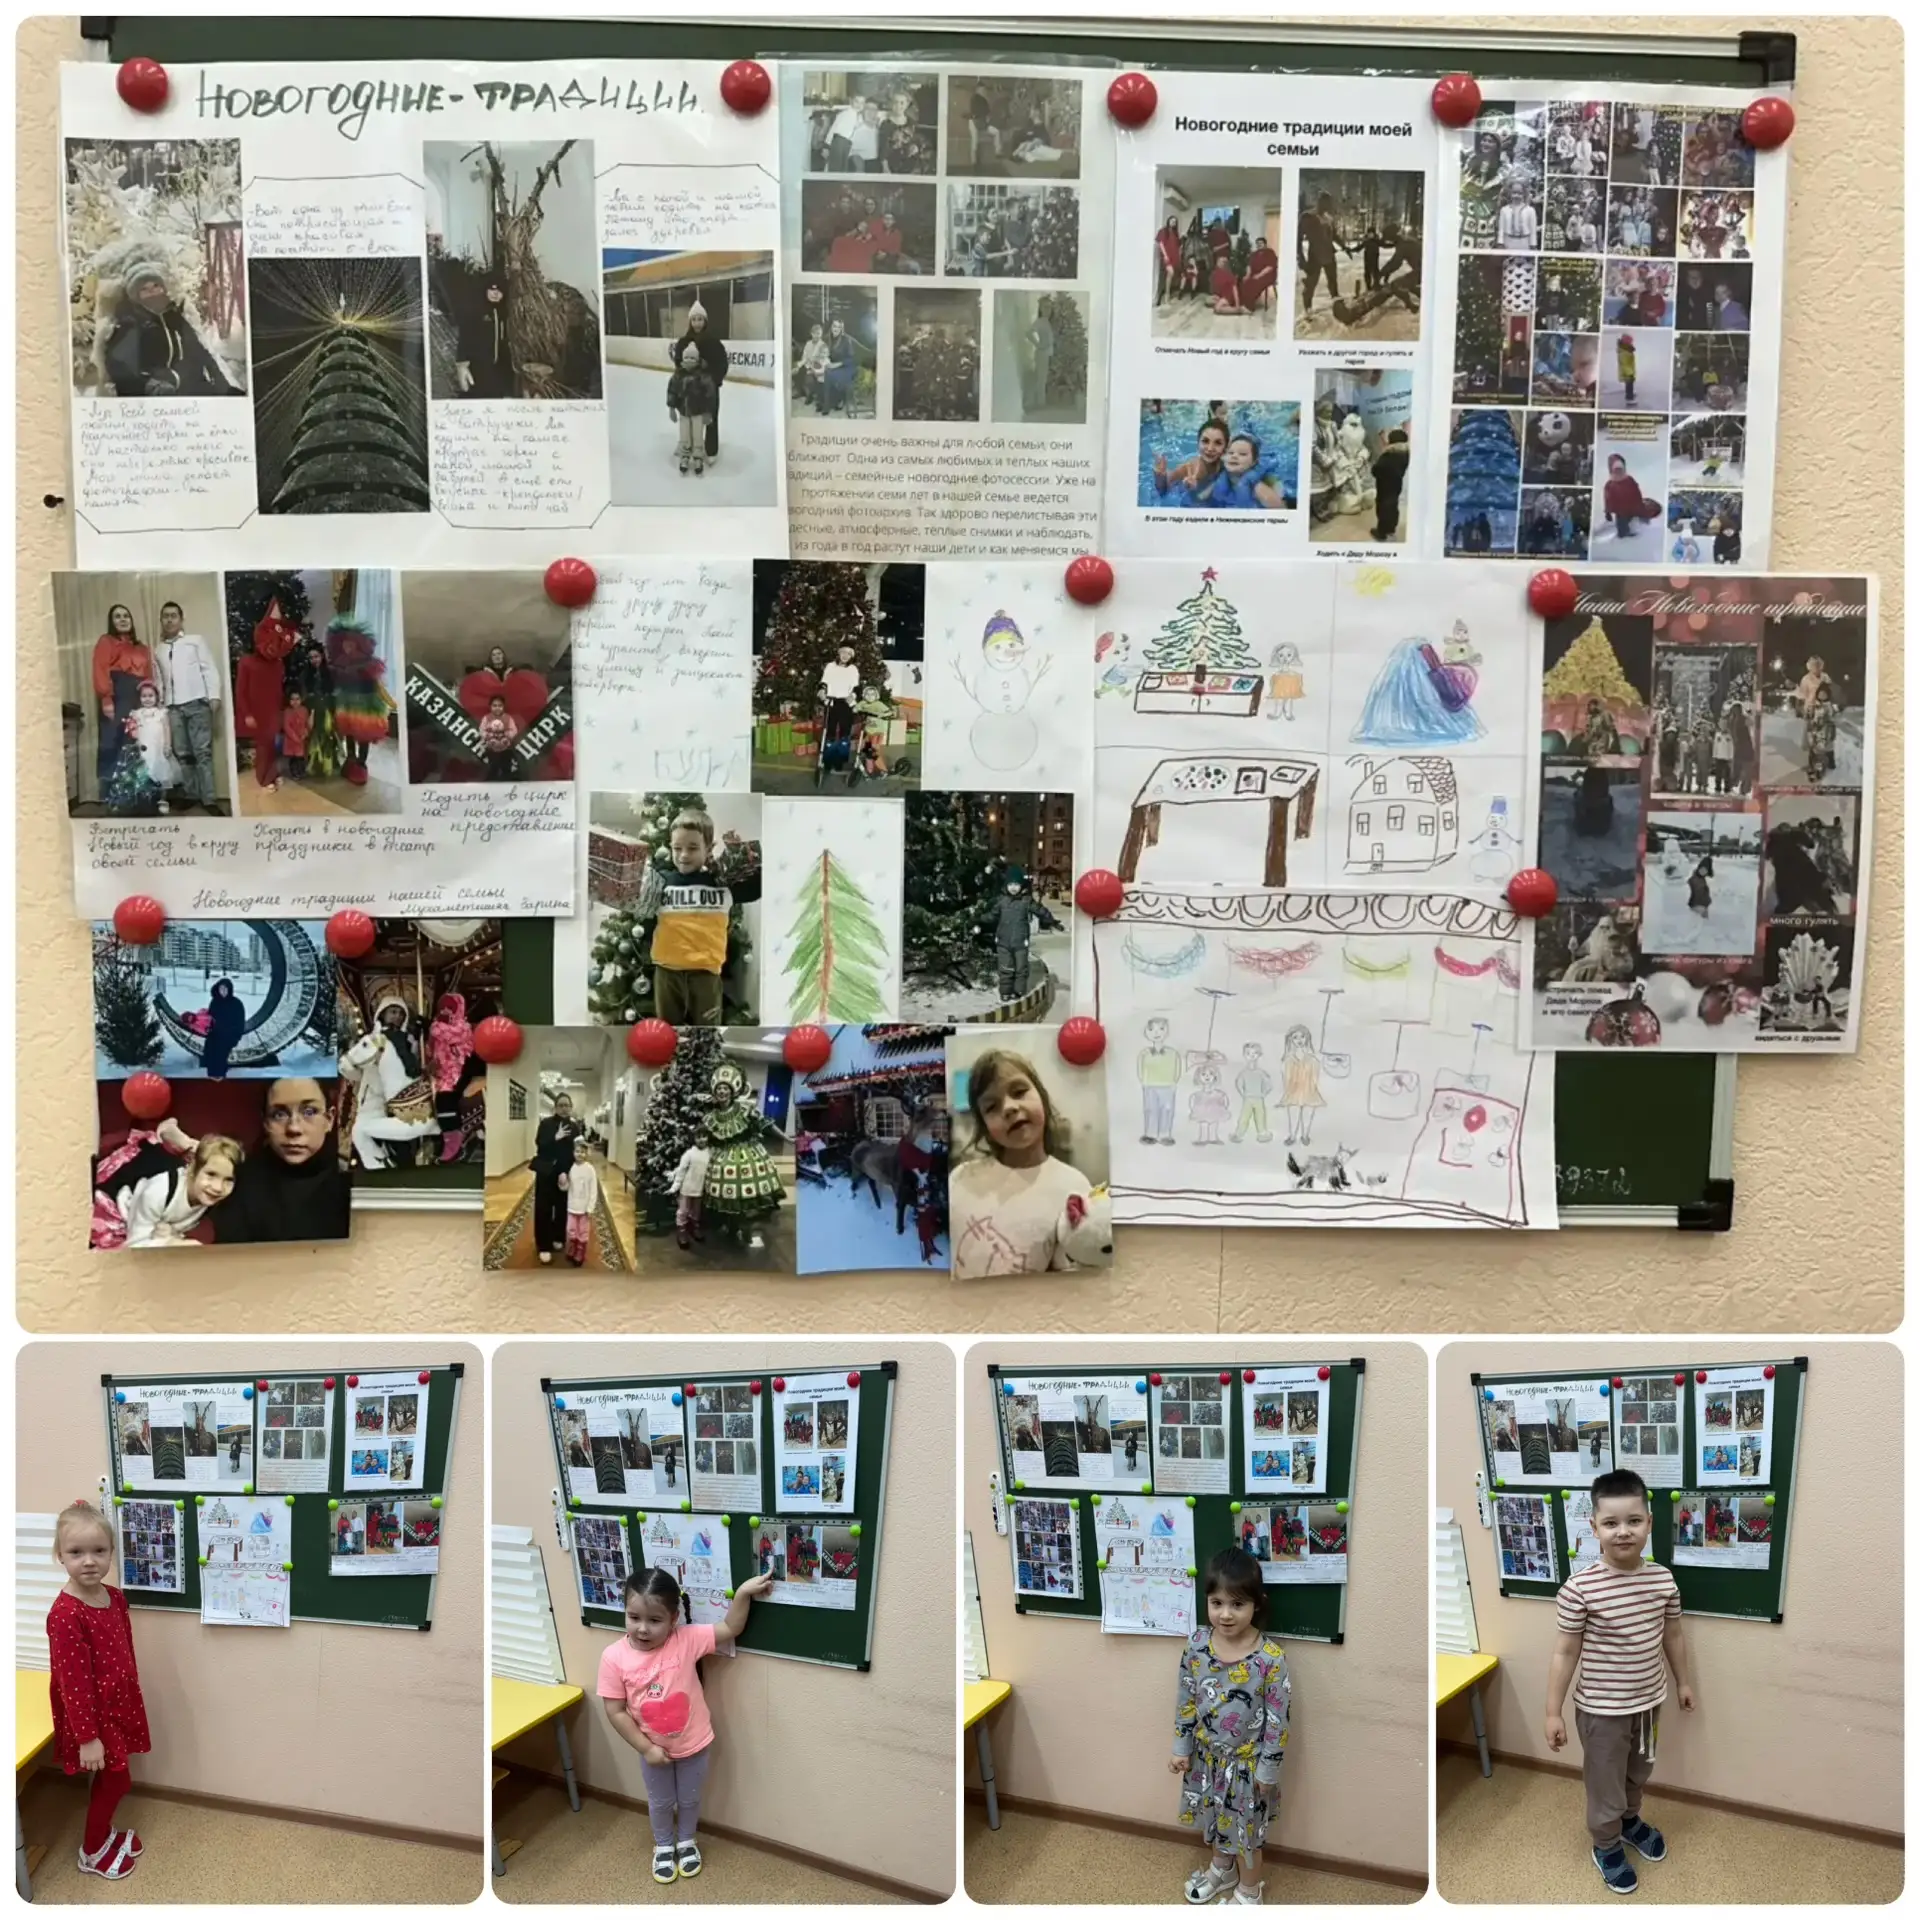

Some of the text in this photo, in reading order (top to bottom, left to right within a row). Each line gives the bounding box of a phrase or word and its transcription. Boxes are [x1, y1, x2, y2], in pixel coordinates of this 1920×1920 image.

[1175, 116, 1412, 136] Новогодние традиции моей
[1267, 143, 1319, 156] семьи
[801, 433, 858, 447] Традиции
[861, 437, 898, 447] очень
[901, 438, 940, 447] важны
[942, 439, 964, 449] для
[966, 437, 1005, 449] любой
[1049, 441, 1072, 450] они
[847, 453, 877, 464] Одна
[881, 456, 894, 464] из
[898, 457, 933, 465] самых
[937, 455, 992, 466] любимых
[995, 458, 1002, 466] и
[1052, 460, 1090, 468] наших
[788, 470, 832, 482] адиций
[845, 472, 904, 482] семейные
[907, 474, 978, 486] новогодние
[1055, 474, 1078, 486] Уже
[1081, 478, 1096, 486] на
[801, 488, 874, 500] протяжении
[877, 491, 906, 500] семи
[910, 490, 928, 500] лет
[932, 492, 940, 500] в
[942, 491, 981, 501] нашей
[985, 492, 1020, 502] семье
[789, 505, 844, 517] вогодний
[917, 506, 936, 518] Так
[941, 509, 989, 520] здорово
[992, 510, 1075, 521] перелистывая
[1077, 512, 1097, 521] эти
[970, 528, 1012, 537] снимки
[1016, 529, 1023, 537] и
[795, 541, 809, 550] из
[812, 541, 838, 552] года
[841, 543, 848, 551] в
[852, 543, 871, 553] год
[874, 543, 910, 555] растут
[914, 544, 946, 553] наши
[949, 544, 976, 555] дети
[979, 545, 986, 554] и
[990, 546, 1007, 554] как
[1011, 547, 1068, 556] меняемся
[404, 676, 571, 764] КАЗАНСК ЦИРК
[660, 889, 724, 905] CHILL OUT
[1770, 917, 1839, 927] много гулять
